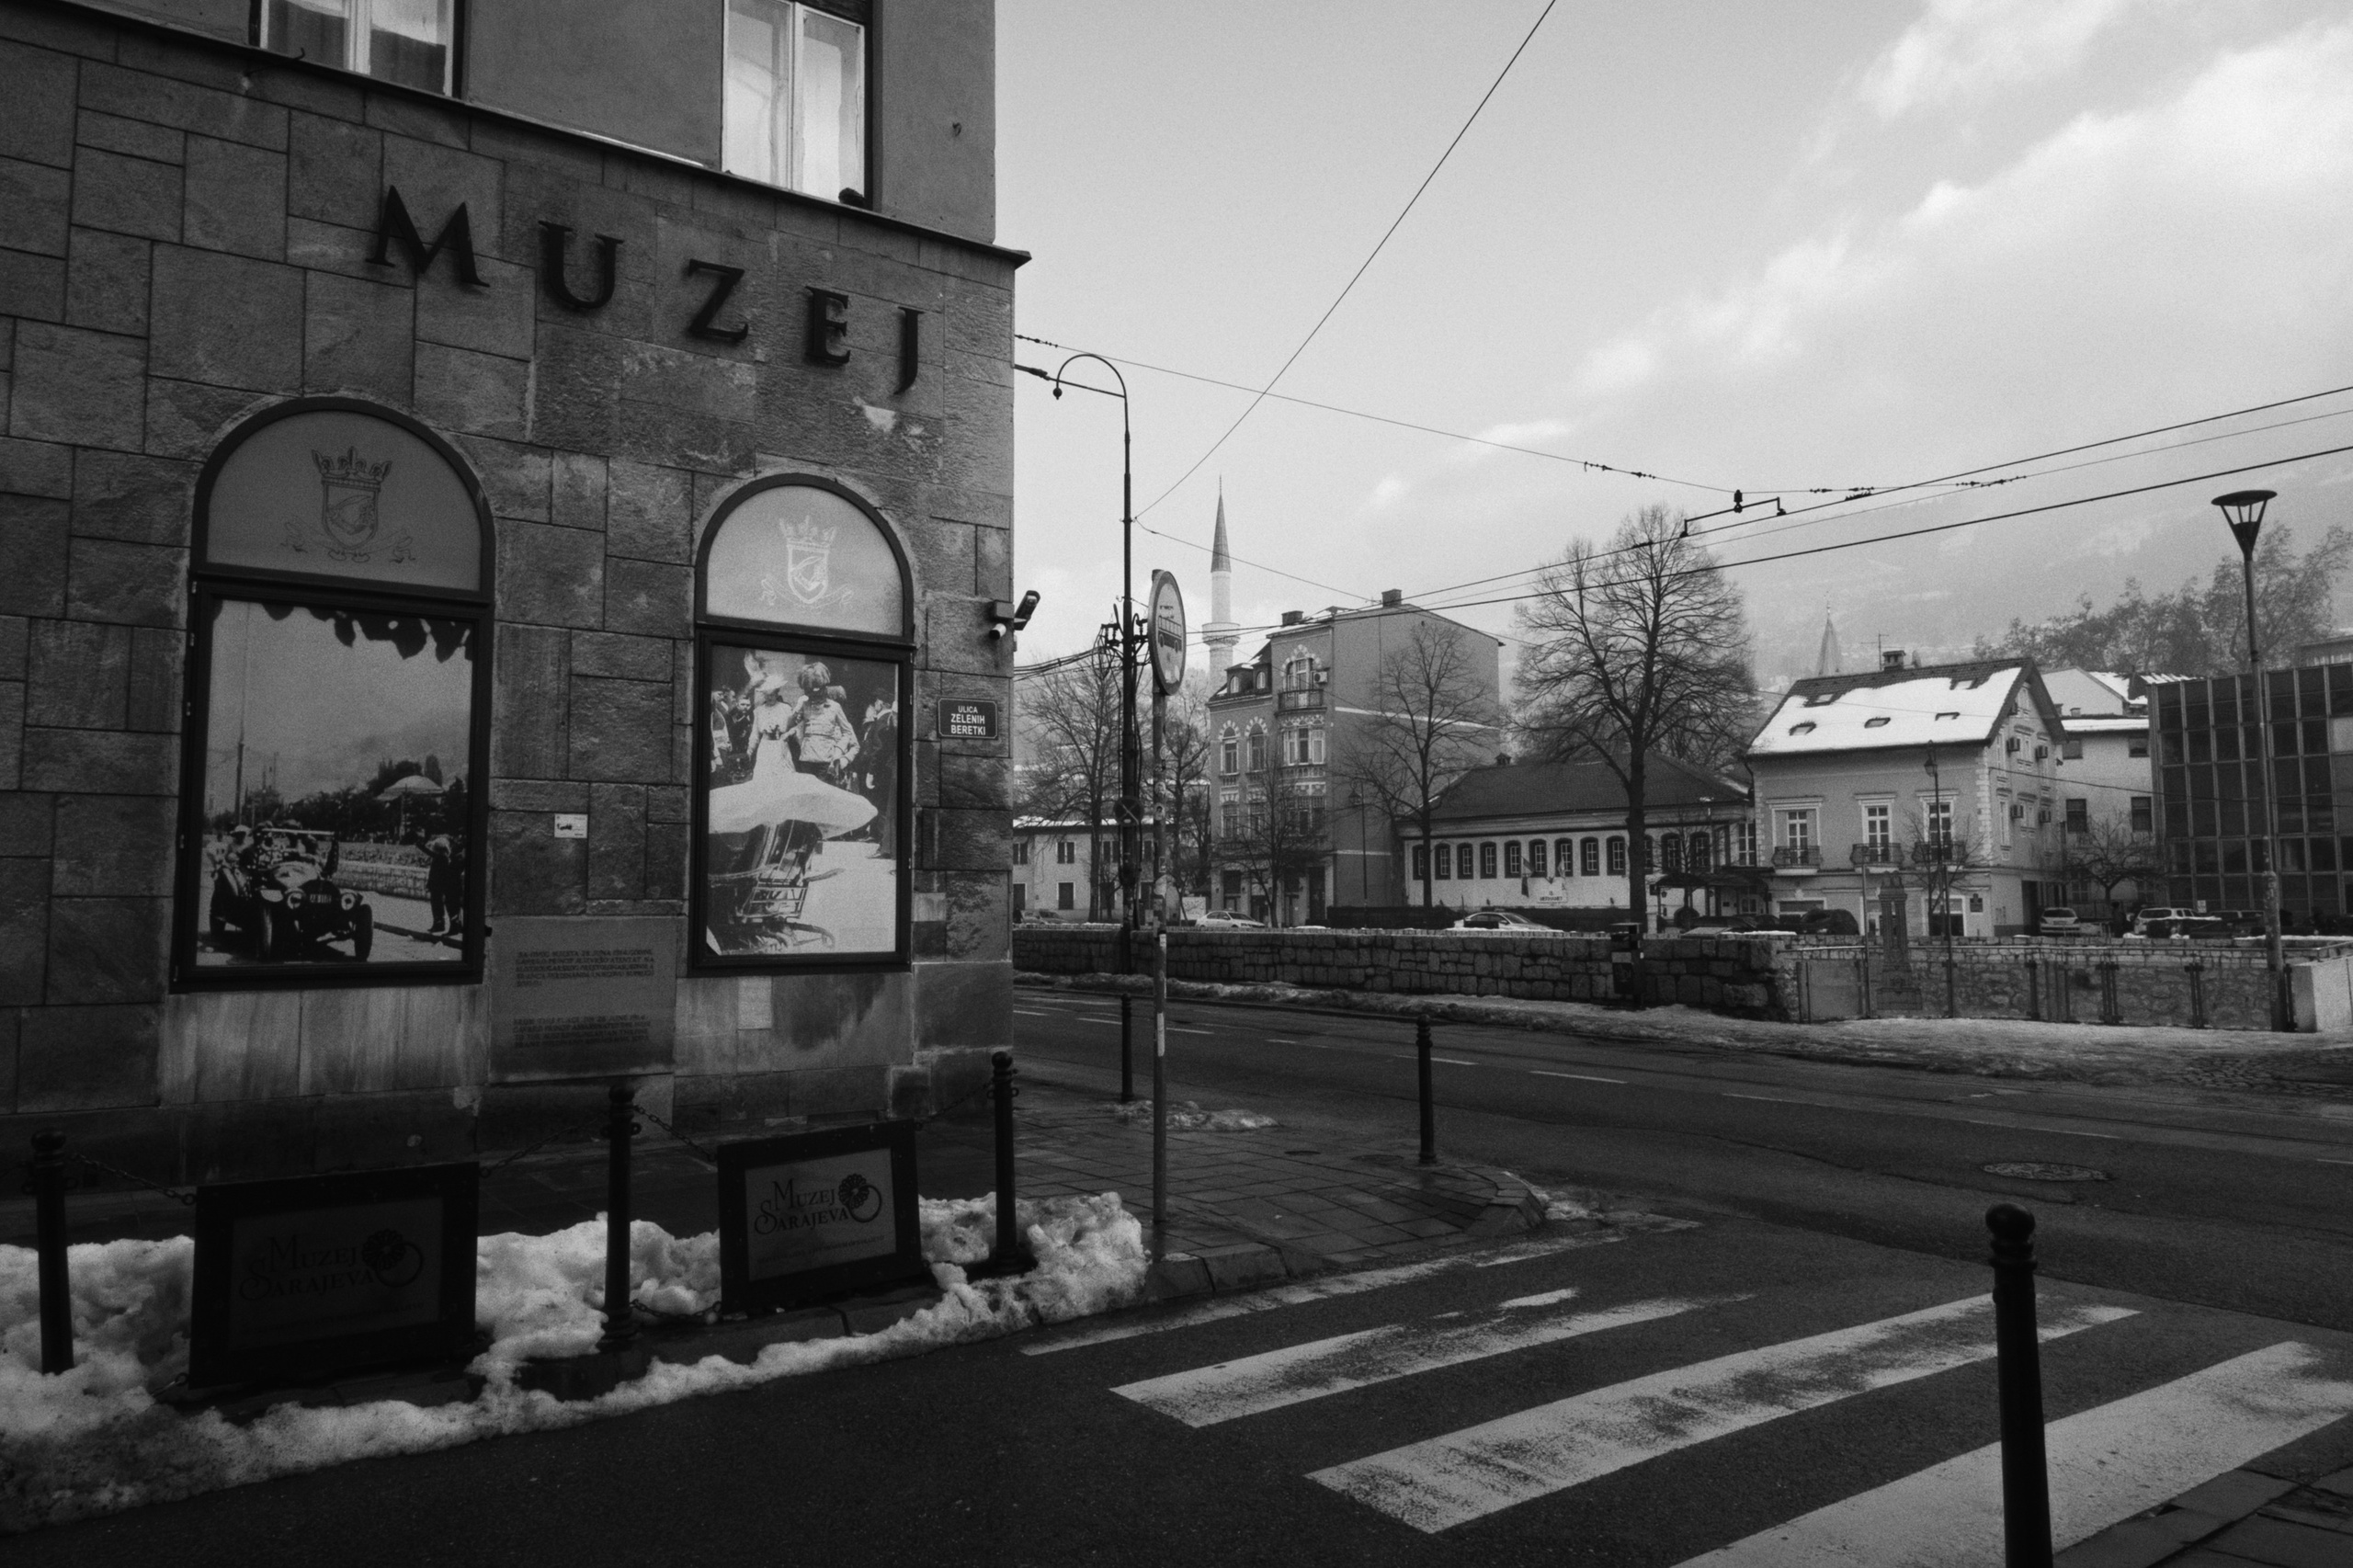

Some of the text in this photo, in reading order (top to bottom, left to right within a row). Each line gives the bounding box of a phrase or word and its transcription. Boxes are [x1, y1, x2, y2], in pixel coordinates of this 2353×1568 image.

[366, 184, 926, 396] MUZEJ
[958, 705, 978, 713] ULICA
[950, 713, 985, 724] ZELENIH
[950, 724, 986, 735] BERETKI
